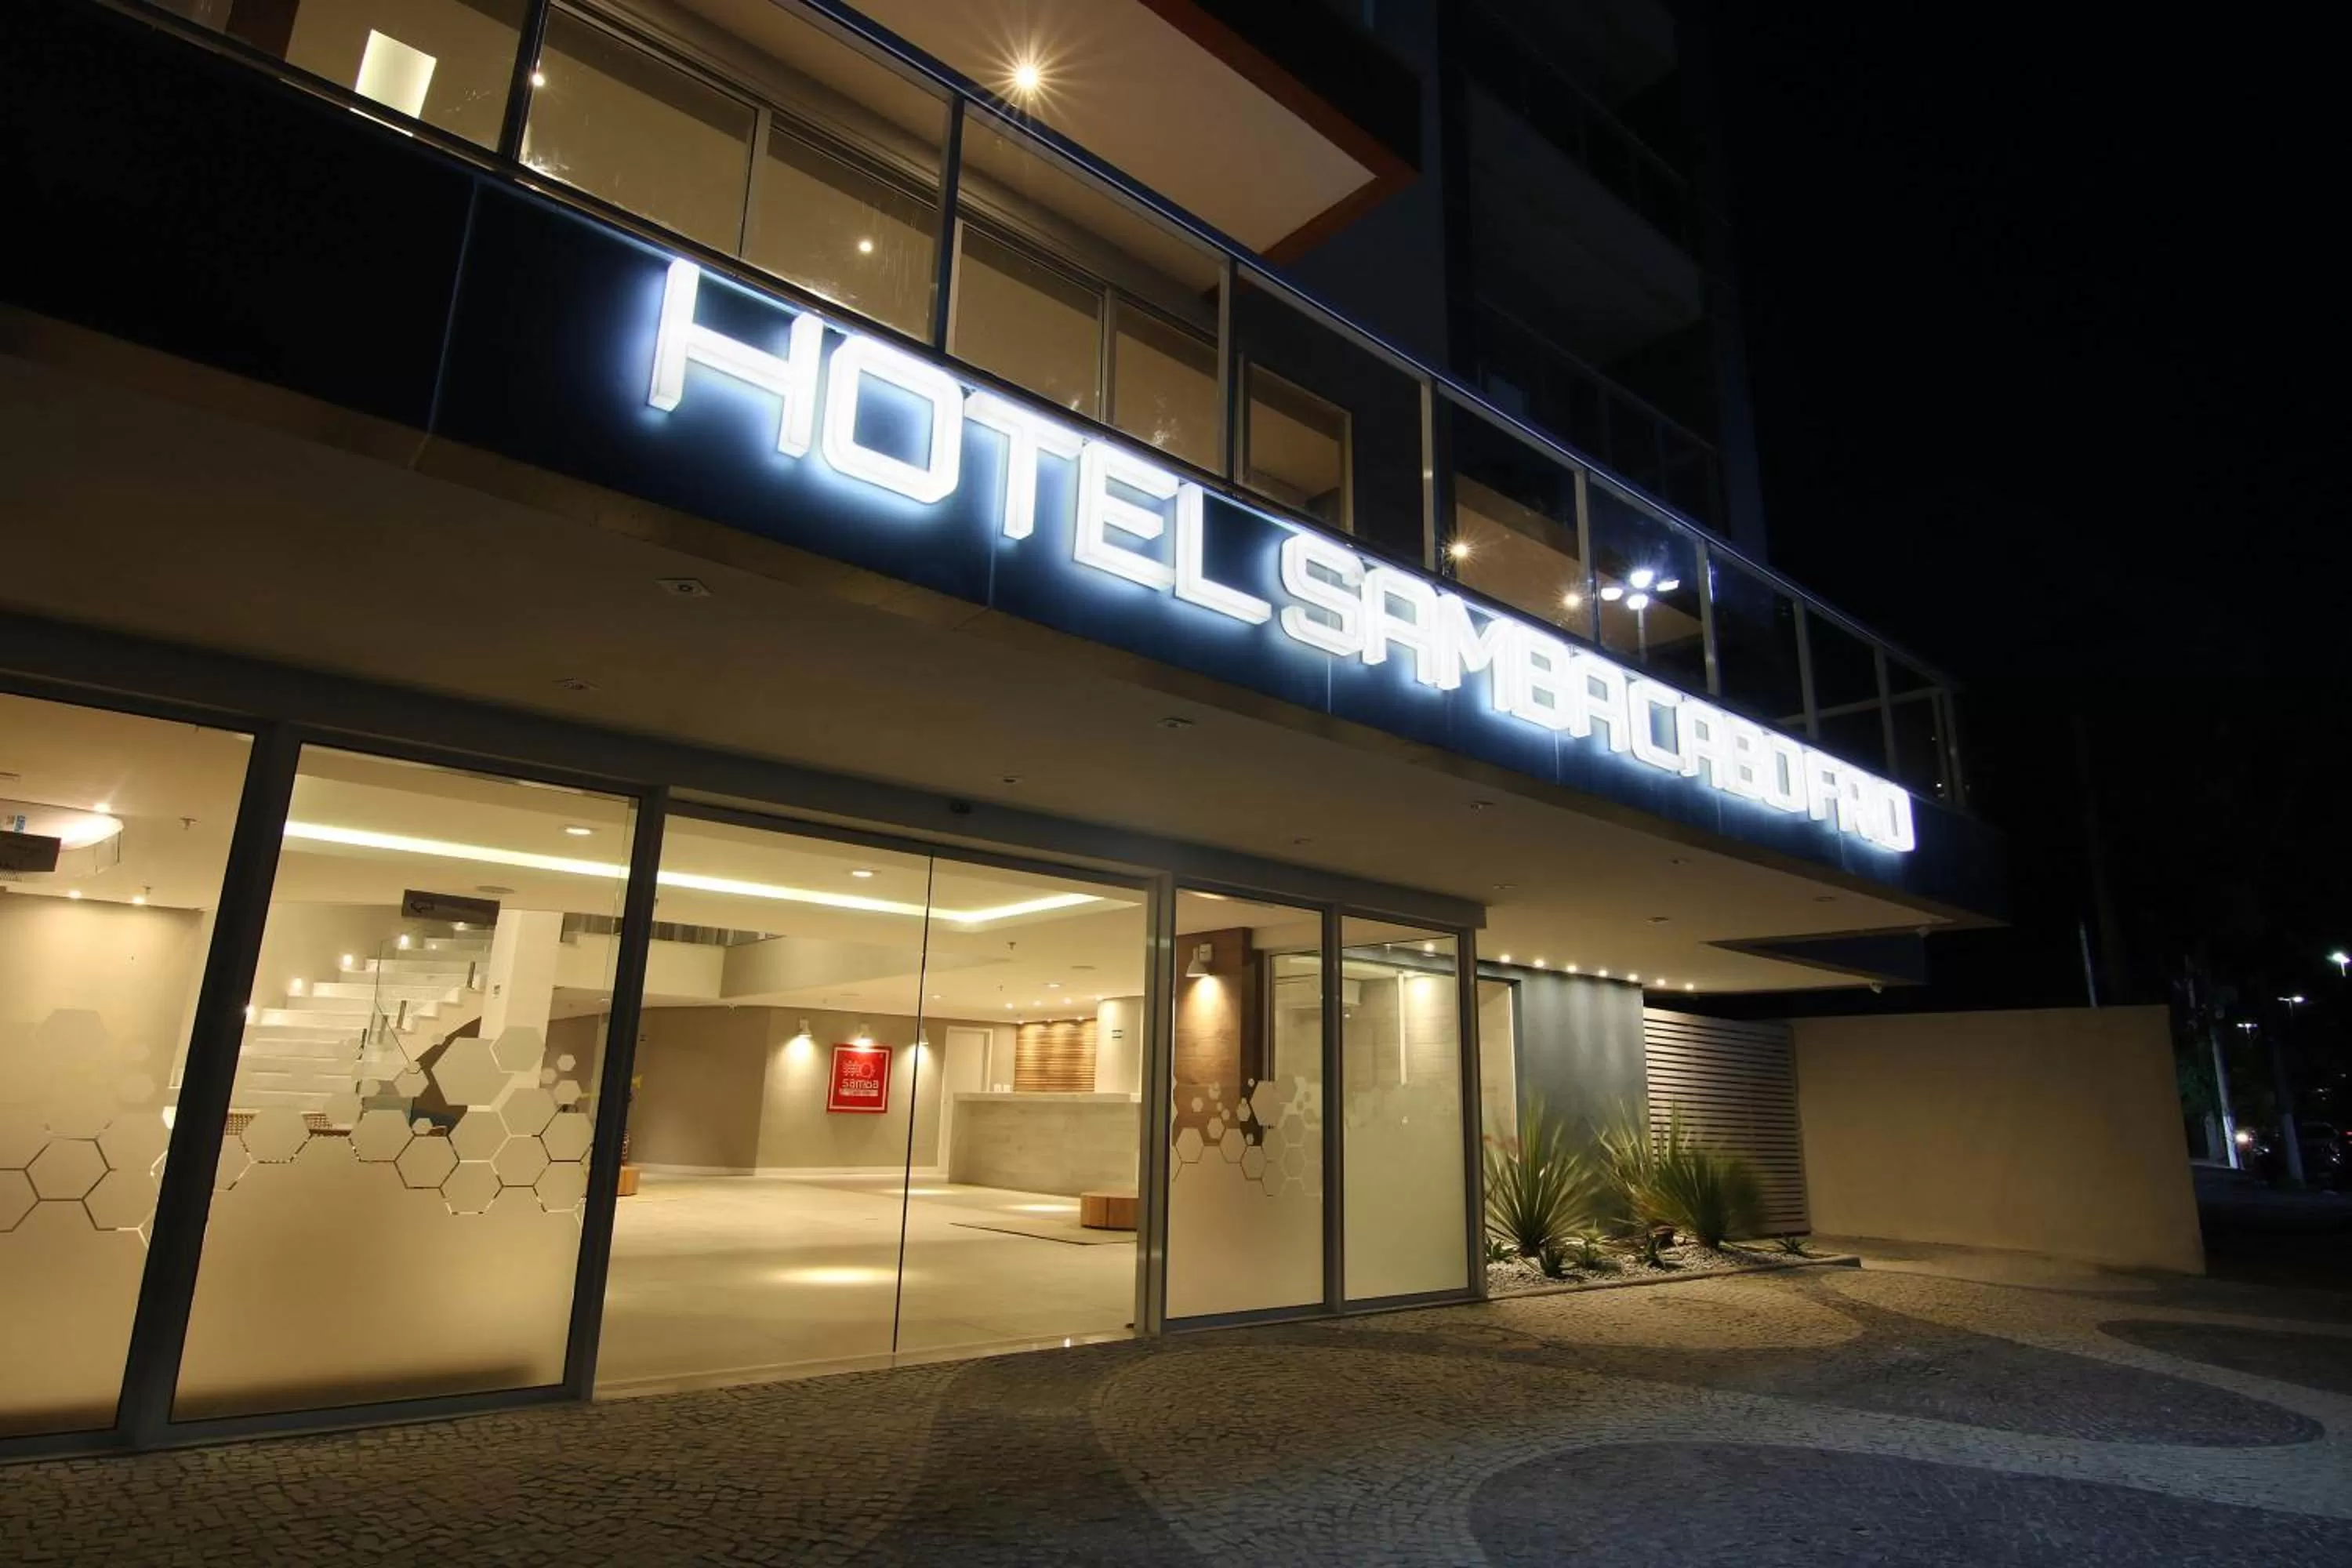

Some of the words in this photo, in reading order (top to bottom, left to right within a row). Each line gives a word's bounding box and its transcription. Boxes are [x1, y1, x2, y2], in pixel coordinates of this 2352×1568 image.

[648, 257, 1272, 625] HOTEL
[1280, 533, 1628, 753] SAMBA
[841, 1078, 879, 1089] samba
